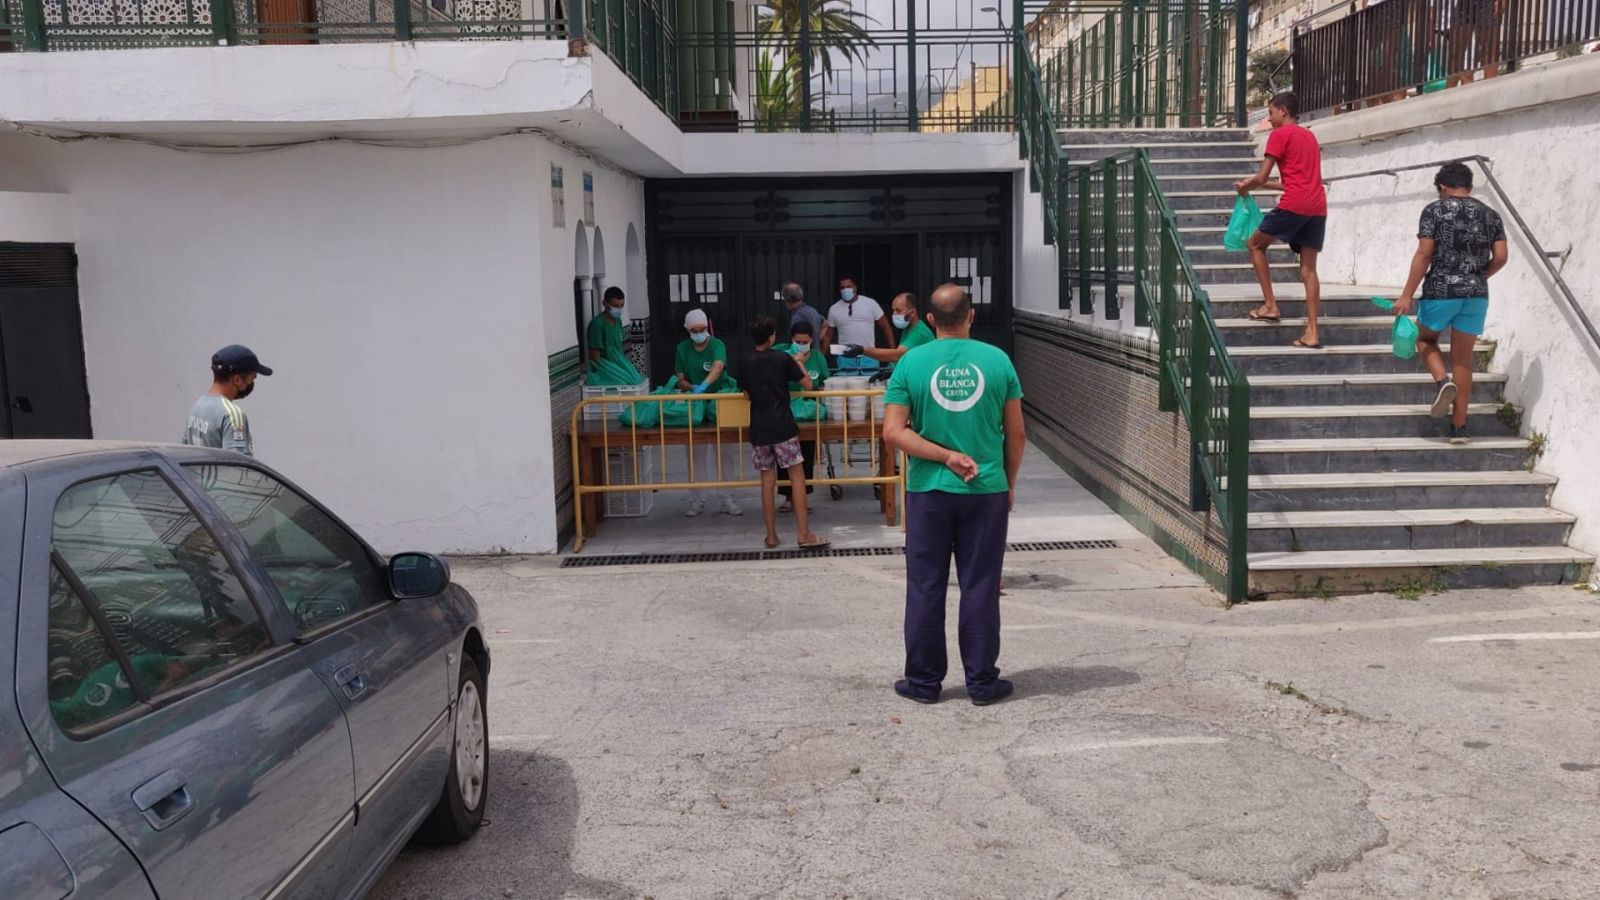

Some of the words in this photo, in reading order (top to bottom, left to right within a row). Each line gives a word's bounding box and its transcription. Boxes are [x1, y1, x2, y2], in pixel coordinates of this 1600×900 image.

[945, 368, 970, 377] LUNA
[939, 379, 976, 388] BLANCA
[945, 389, 969, 397] CEUTA
